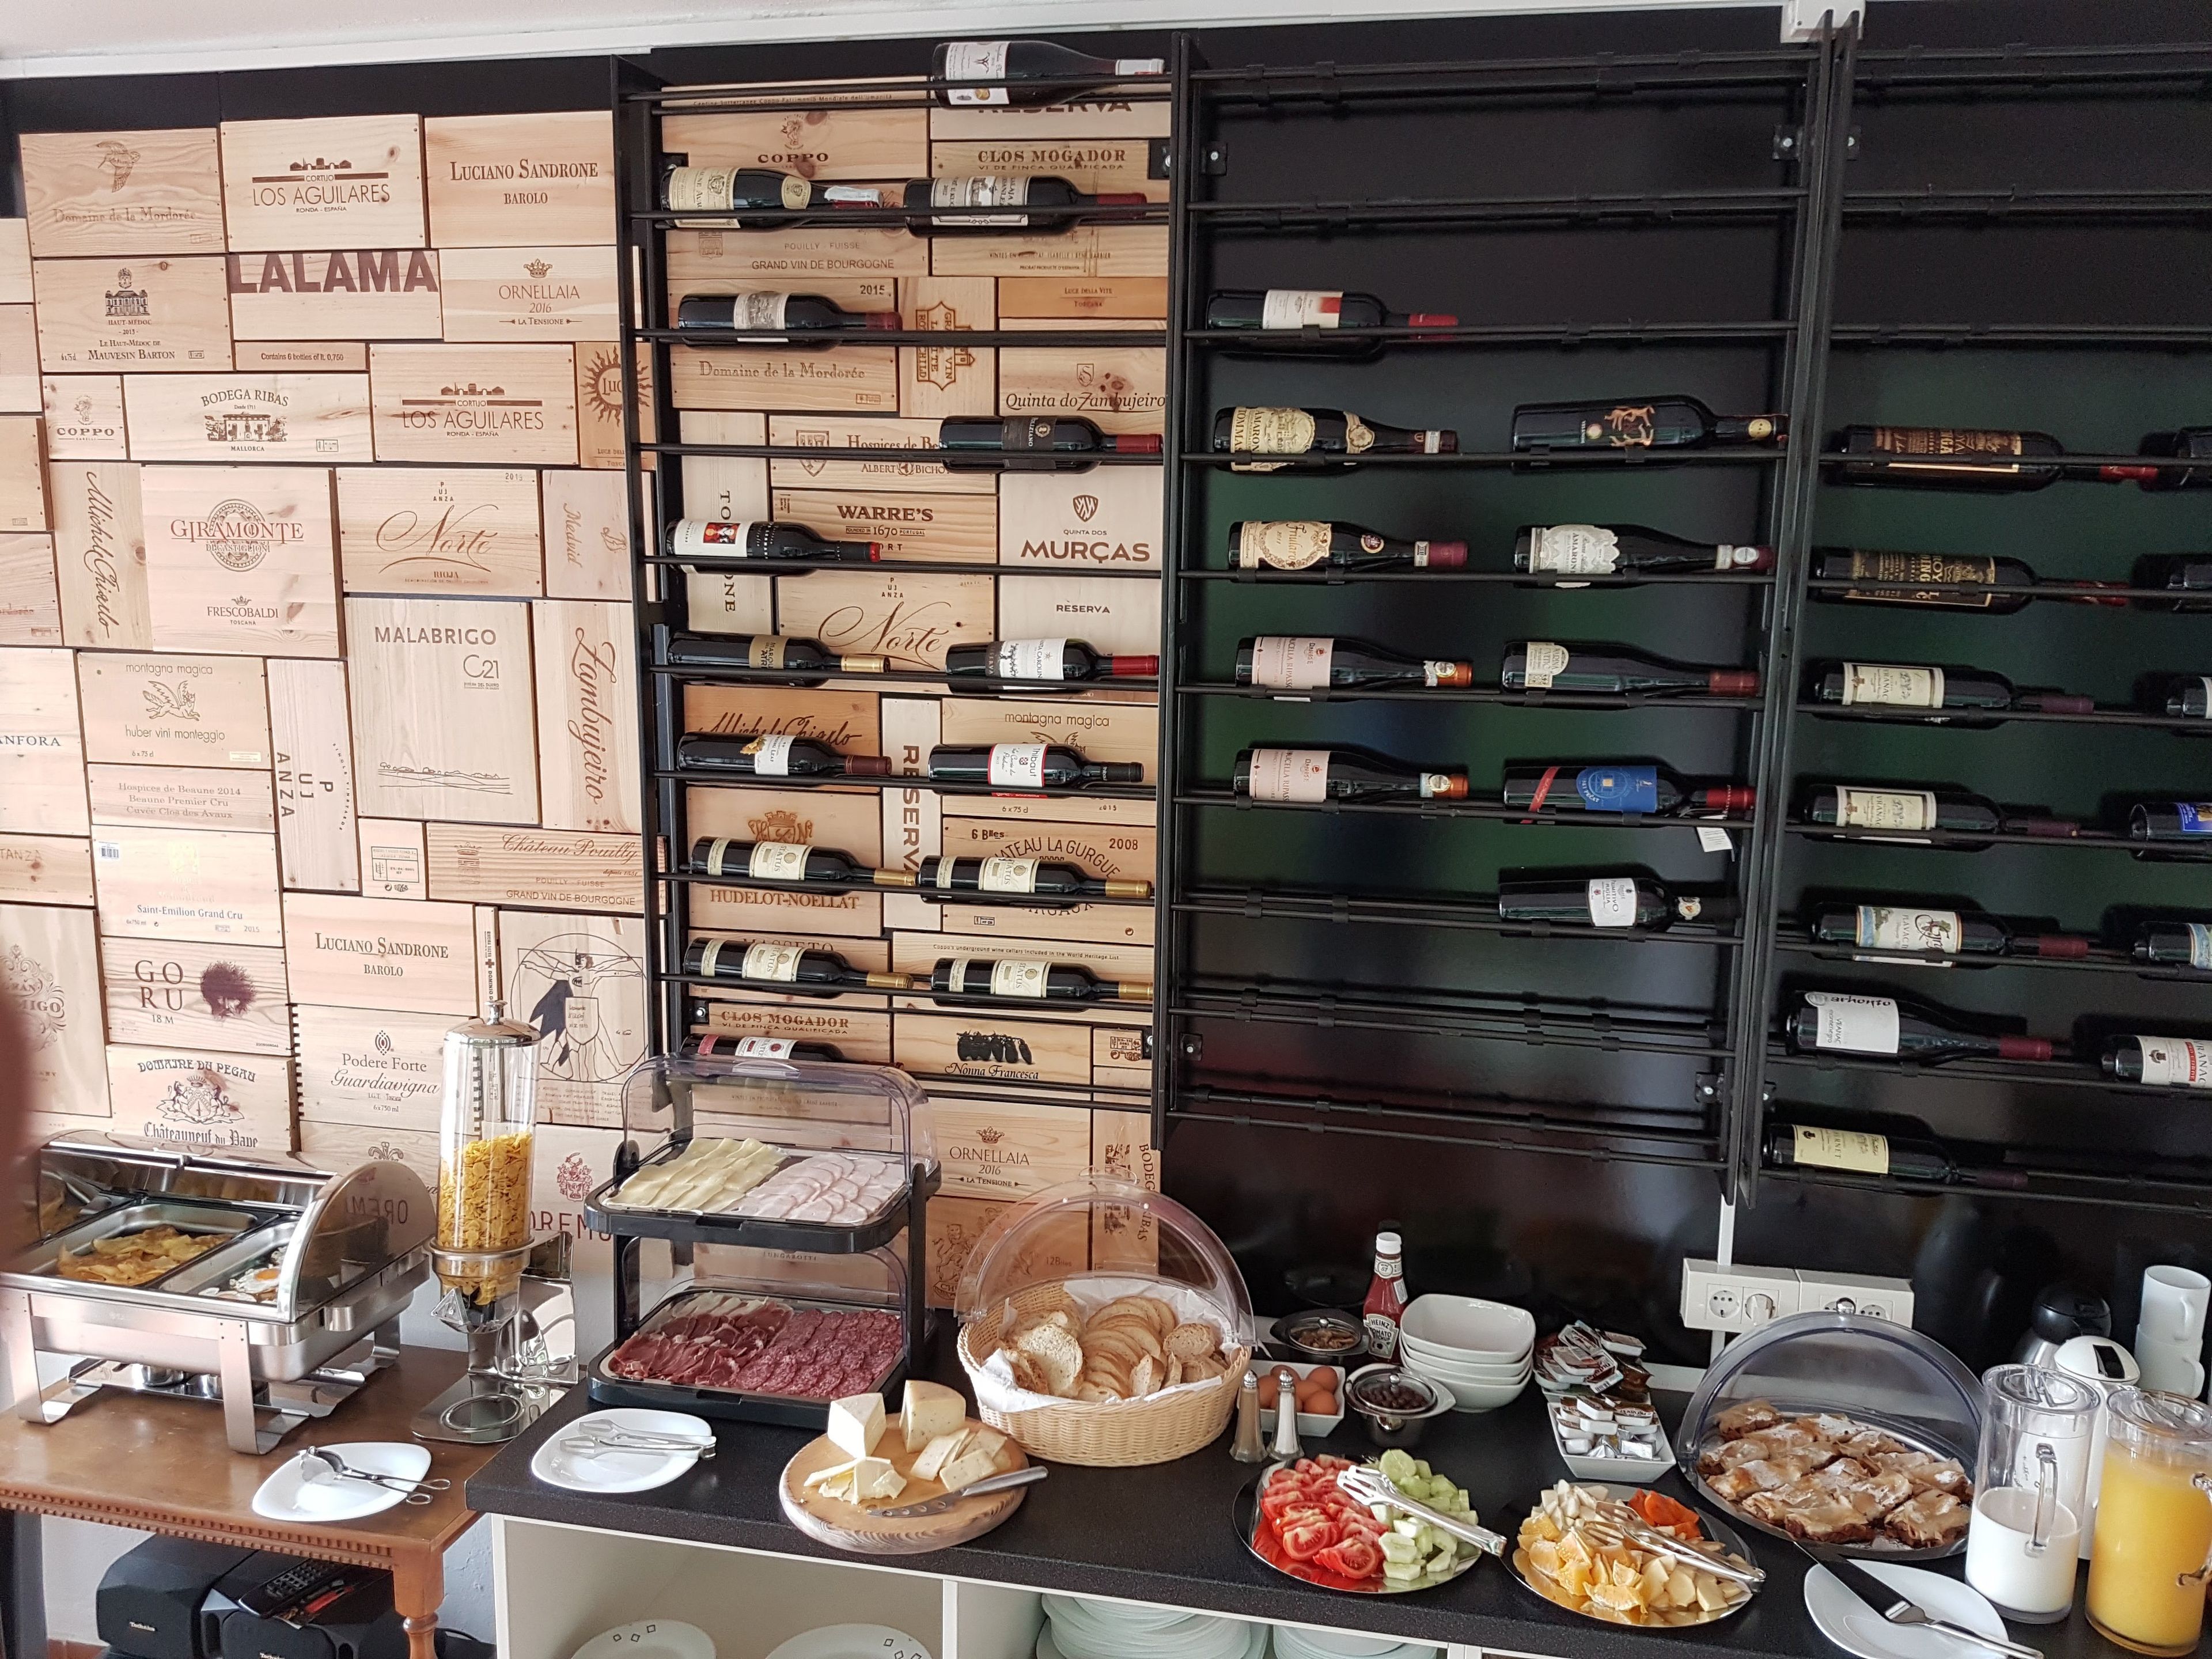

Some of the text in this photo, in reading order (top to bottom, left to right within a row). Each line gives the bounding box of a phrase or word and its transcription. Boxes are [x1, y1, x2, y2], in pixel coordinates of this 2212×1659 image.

[757, 152, 830, 165] COPPO
[978, 149, 1126, 162] CLOS MOGADOR
[450, 158, 598, 181] LUCIANO SANDRONE
[253, 184, 390, 206] LOS AGUILARES
[504, 192, 548, 204] BAROLO
[230, 251, 439, 294] LALAMA
[752, 259, 895, 270] GRAND VIN DE BOURGOGNE
[499, 285, 580, 300] ORNELLAIA
[859, 285, 885, 296] 2015
[529, 302, 552, 313] 2016
[88, 350, 136, 361] MAUVESIN
[138, 349, 175, 360] BARTON
[699, 361, 760, 377] Domaine
[764, 362, 779, 377] de
[783, 362, 794, 378] la
[201, 389, 289, 406] BODEGA RIBAS
[1006, 393, 1055, 411] Quinta
[1060, 393, 1078, 408] do
[403, 411, 544, 430] LOS AGUILARES
[57, 427, 114, 436] COPPO
[171, 520, 304, 544] GIRAMONTE
[873, 526, 897, 539] 1670
[1020, 539, 1150, 564] MURÇAS
[207, 606, 278, 619] FRESCOBALDI
[1056, 604, 1111, 614] RESERVA
[375, 627, 497, 645] MALABRIGO
[126, 663, 213, 677] montagna magica
[463, 654, 499, 679] C21
[1005, 712, 1110, 729] montagna magica
[126, 725, 225, 743] huber vini monteggio
[217, 787, 241, 796] 2014
[210, 798, 228, 806] Cru
[1109, 839, 1139, 851] 2008
[1048, 836, 1063, 853] LA
[1067, 840, 1121, 878] GURGUE
[506, 889, 636, 906] GRAND VIN DE BOURGOGNE
[710, 889, 860, 910] HUDELOT-NOELLAT
[137, 904, 243, 920] Saint-Emilion Grand Cru
[315, 932, 449, 959] LUCIANO SANDRONE
[363, 964, 403, 977] BAROLO
[165, 1016, 174, 1024] M
[721, 1011, 849, 1028] CLOS MOGADOR
[137, 1058, 257, 1082] DOMAINE DU PEGAU
[342, 1053, 427, 1072] Podere Forte
[330, 1069, 441, 1098] Guardiavigna
[949, 1146, 1030, 1166] ORNELLAIA
[978, 1164, 1001, 1176] 2016
[1371, 1319, 1391, 1330] HEINZ
